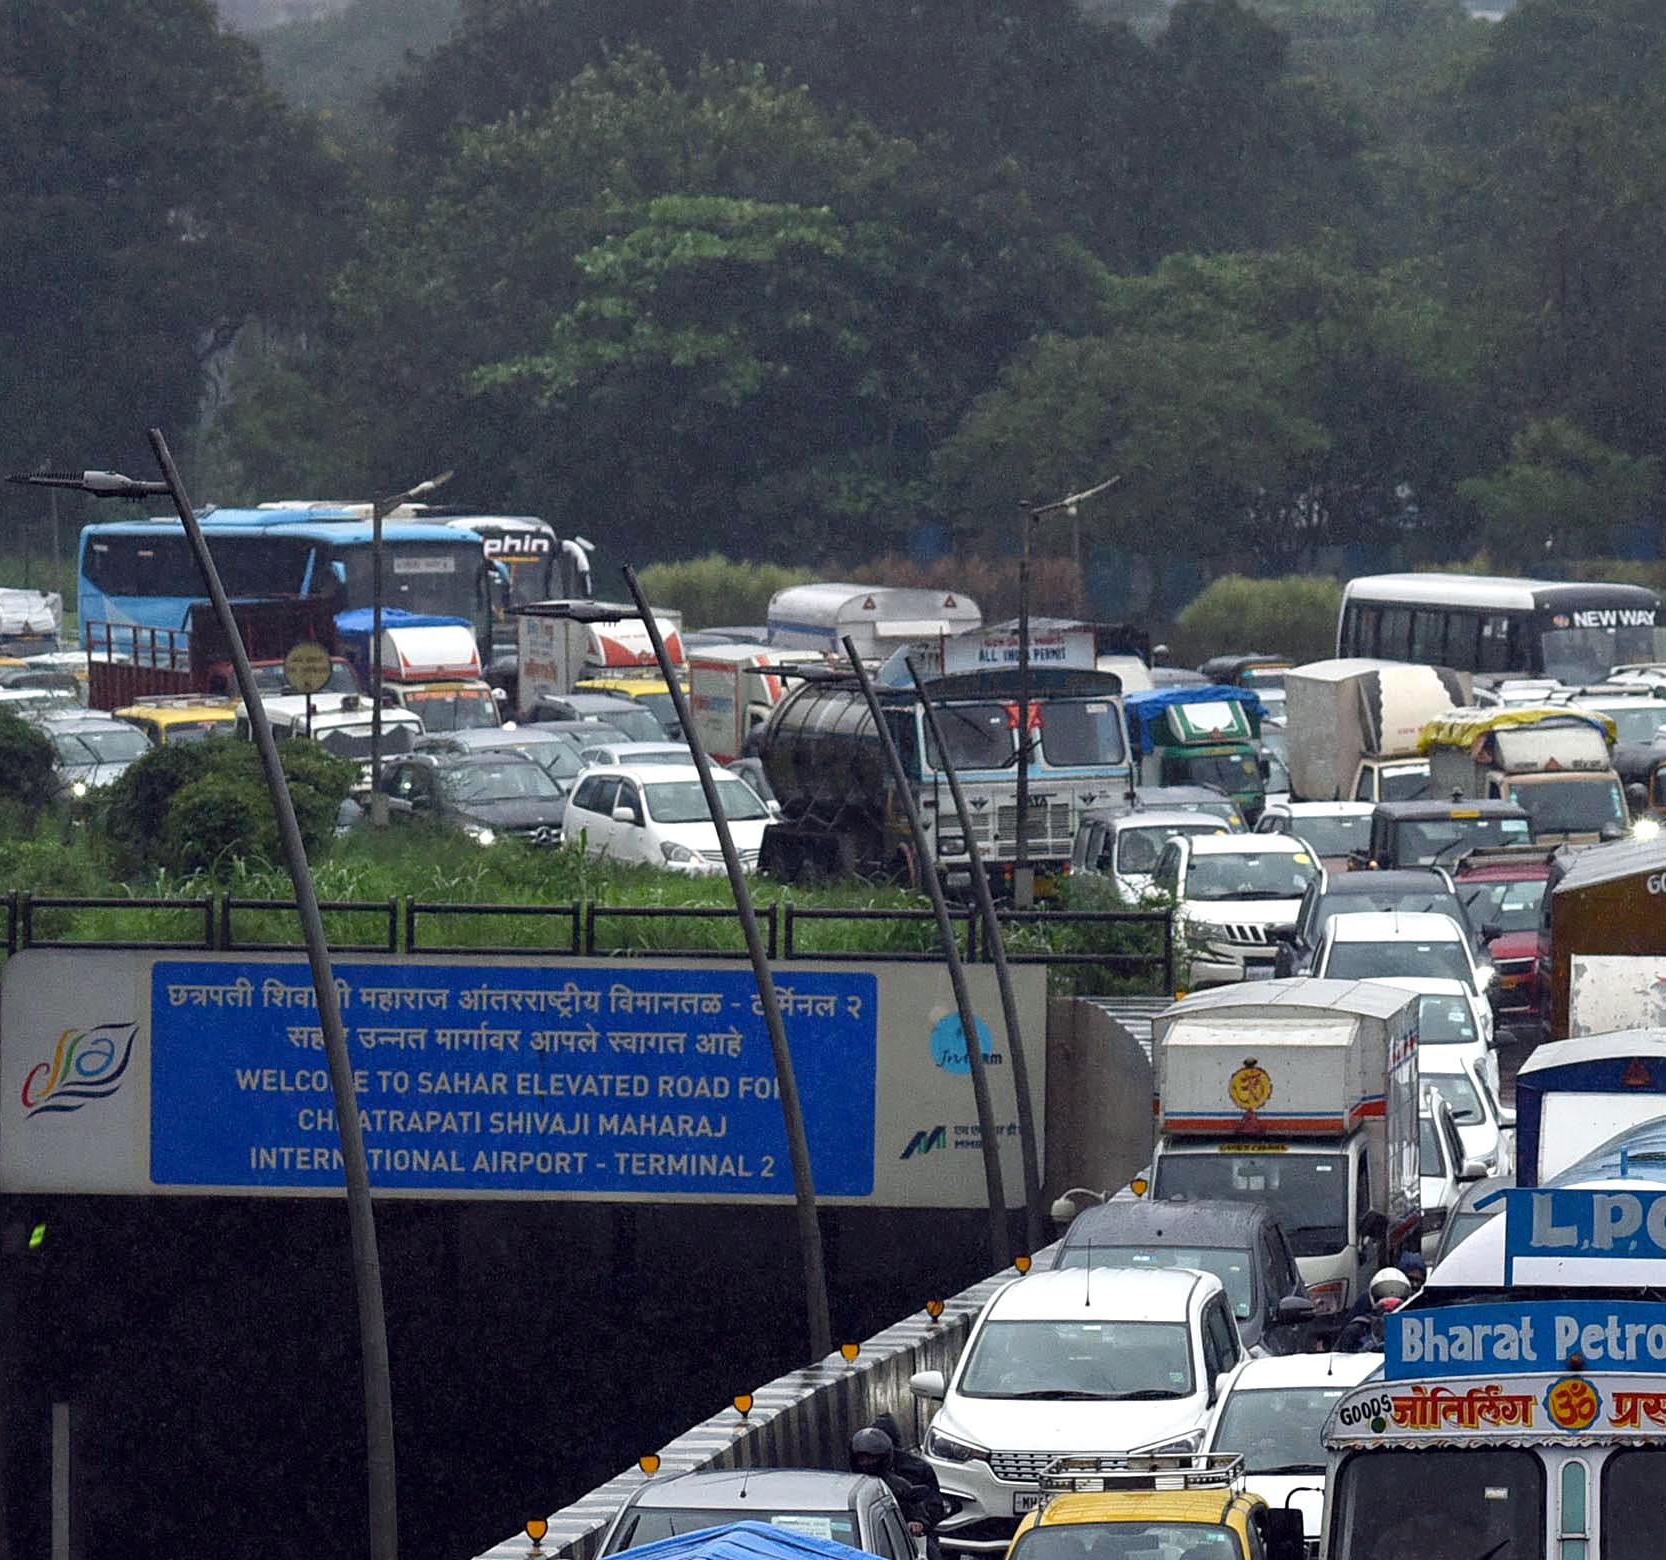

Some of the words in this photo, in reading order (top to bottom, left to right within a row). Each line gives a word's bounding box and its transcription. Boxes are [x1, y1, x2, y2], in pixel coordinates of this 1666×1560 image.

[484, 535, 550, 559] phin
[1572, 610, 1619, 628] NEW
[1619, 610, 1656, 627] WAY
[978, 648, 998, 662] ALL
[167, 984, 254, 1011] छत्रपती
[359, 987, 450, 1013] महाराज
[459, 988, 600, 1017] आंतरराष्ट्रीय
[608, 988, 723, 1017] विमानतळ
[845, 998, 862, 1018] २
[357, 1028, 427, 1052] उन्नत
[435, 1025, 521, 1052] मार्गावर
[530, 1024, 598, 1055] आपले
[607, 1030, 687, 1057] स्वागत
[695, 1027, 744, 1058] आहे
[236, 1069, 369, 1093] WELCOE
[377, 1071, 409, 1093] TO
[416, 1071, 508, 1095] SAHAR
[530, 1073, 651, 1097] ELEVATED
[658, 1075, 732, 1099] ROAD
[298, 1110, 481, 1134] CHATRAPATI
[489, 1112, 591, 1137] SHIVAJI
[599, 1114, 727, 1139] MAHARAJ
[249, 1147, 461, 1174] INTERNTIONAL
[472, 1150, 587, 1177] AIRPORT
[615, 1153, 754, 1178] TERMINAL
[760, 1156, 776, 1178] 2
[1401, 1315, 1537, 1364] Bharat
[1339, 1394, 1392, 1426] GOODS
